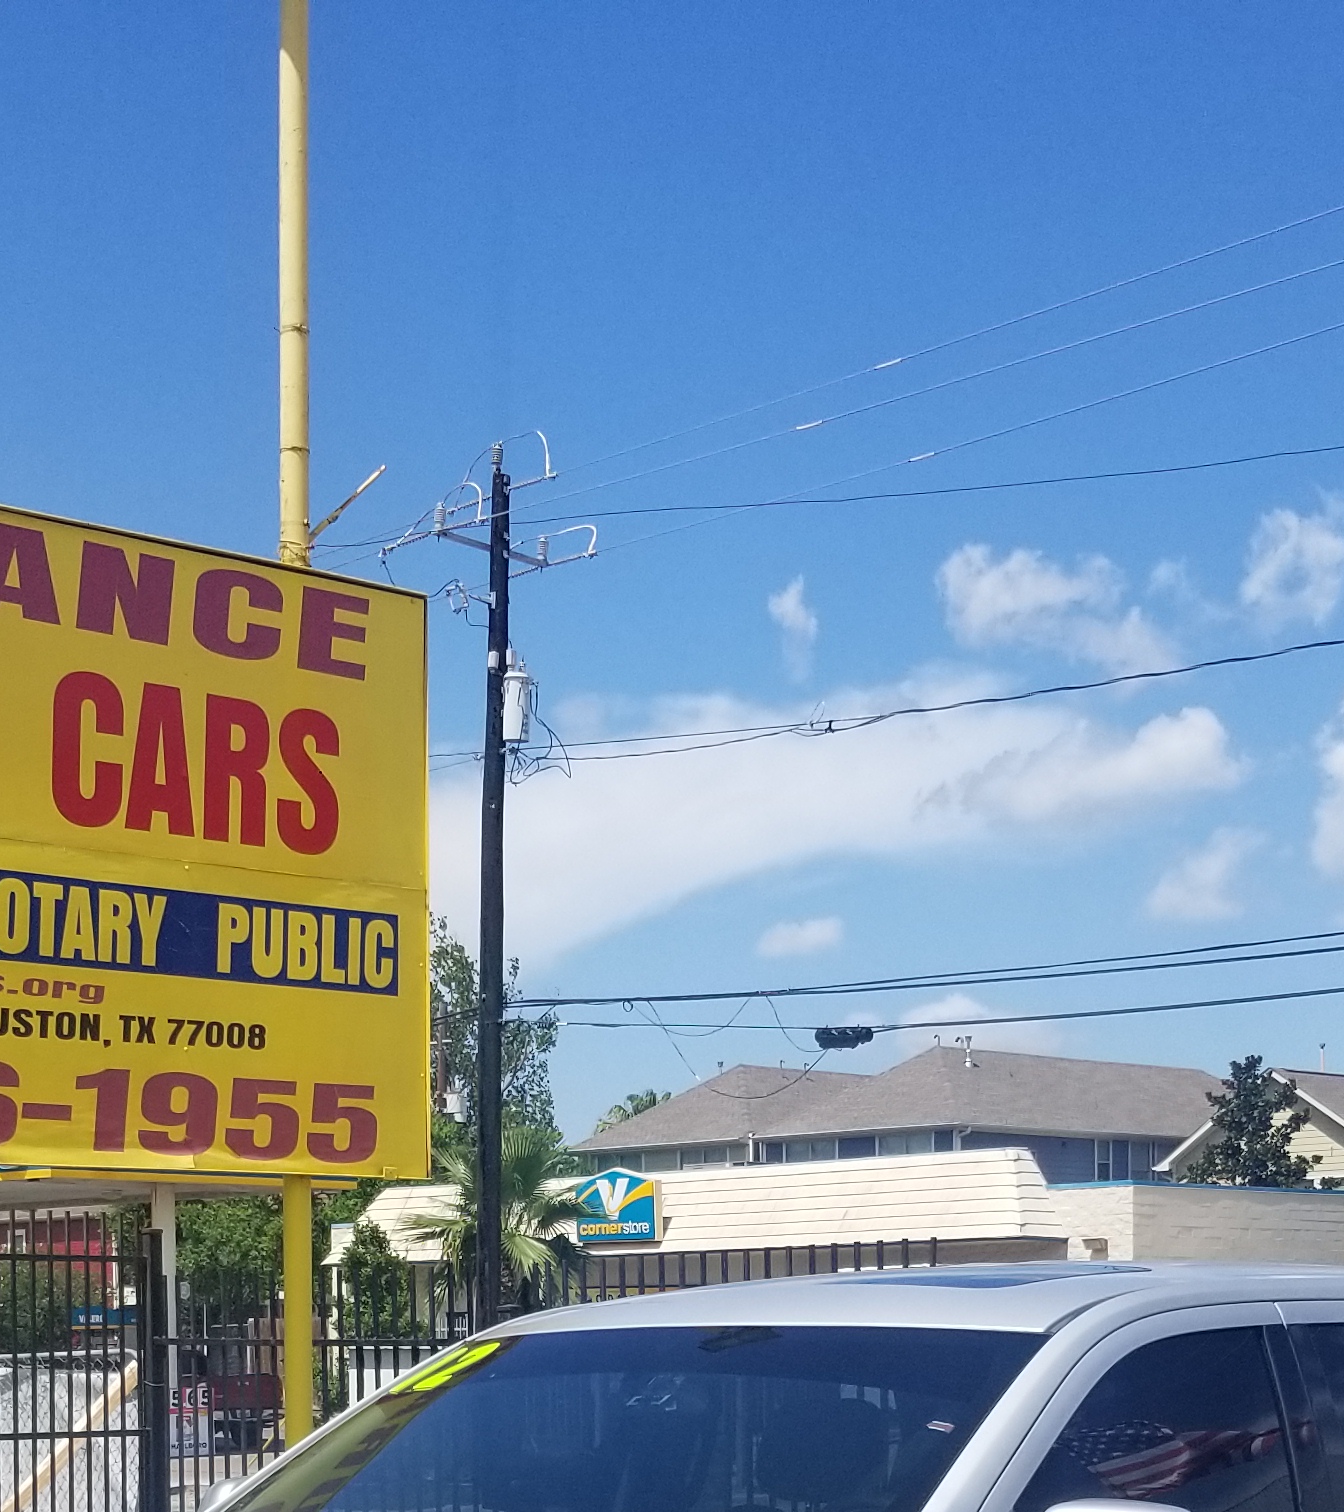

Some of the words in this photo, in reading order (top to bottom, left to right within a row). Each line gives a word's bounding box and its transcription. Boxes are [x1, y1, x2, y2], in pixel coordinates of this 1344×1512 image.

[51, 671, 340, 856] CARS
[216, 903, 396, 989] PUBLIC
[119, 1014, 157, 1044] TX
[166, 1019, 267, 1050] 77008
[579, 1220, 650, 1236] cornerstore
